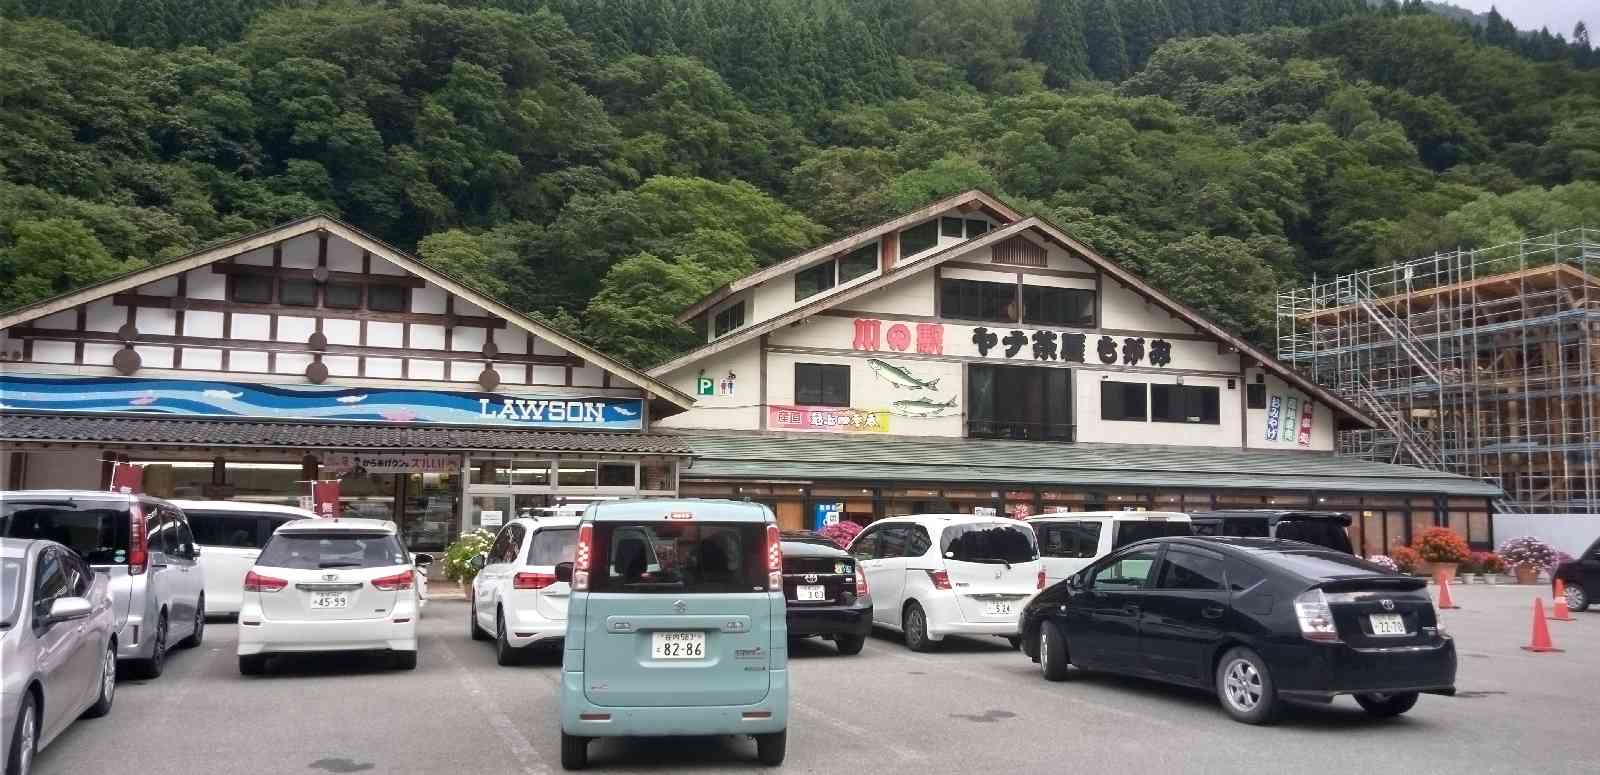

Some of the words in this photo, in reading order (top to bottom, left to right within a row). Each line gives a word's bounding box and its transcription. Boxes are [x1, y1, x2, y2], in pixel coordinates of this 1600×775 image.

[852, 318, 945, 356] 川の駅
[971, 326, 1085, 364] ヤナ茶屋
[1096, 334, 1172, 367] もがみ
[700, 378, 712, 394] P
[479, 398, 606, 422] LAWSON
